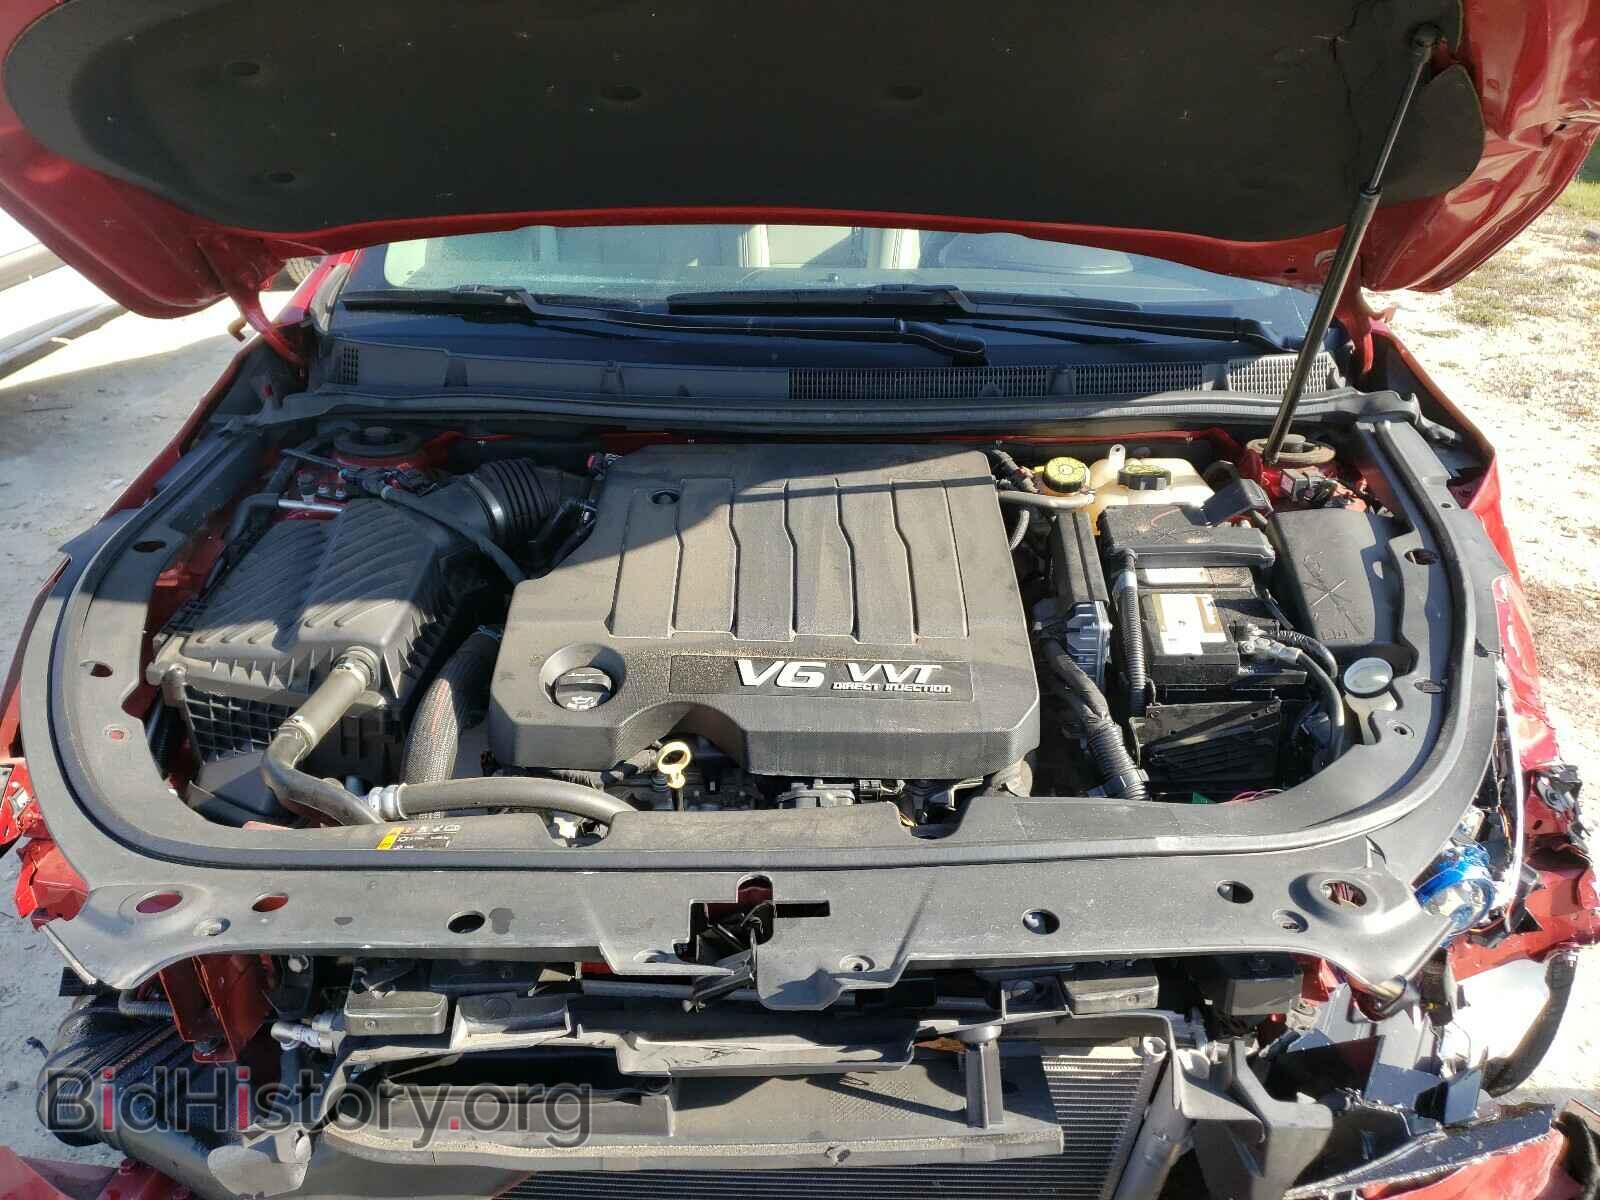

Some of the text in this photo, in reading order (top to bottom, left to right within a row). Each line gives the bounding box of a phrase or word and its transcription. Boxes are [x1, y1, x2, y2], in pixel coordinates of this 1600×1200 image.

[735, 659, 943, 688] V6 VVT
[832, 682, 952, 694] DIRECT INJECTION
